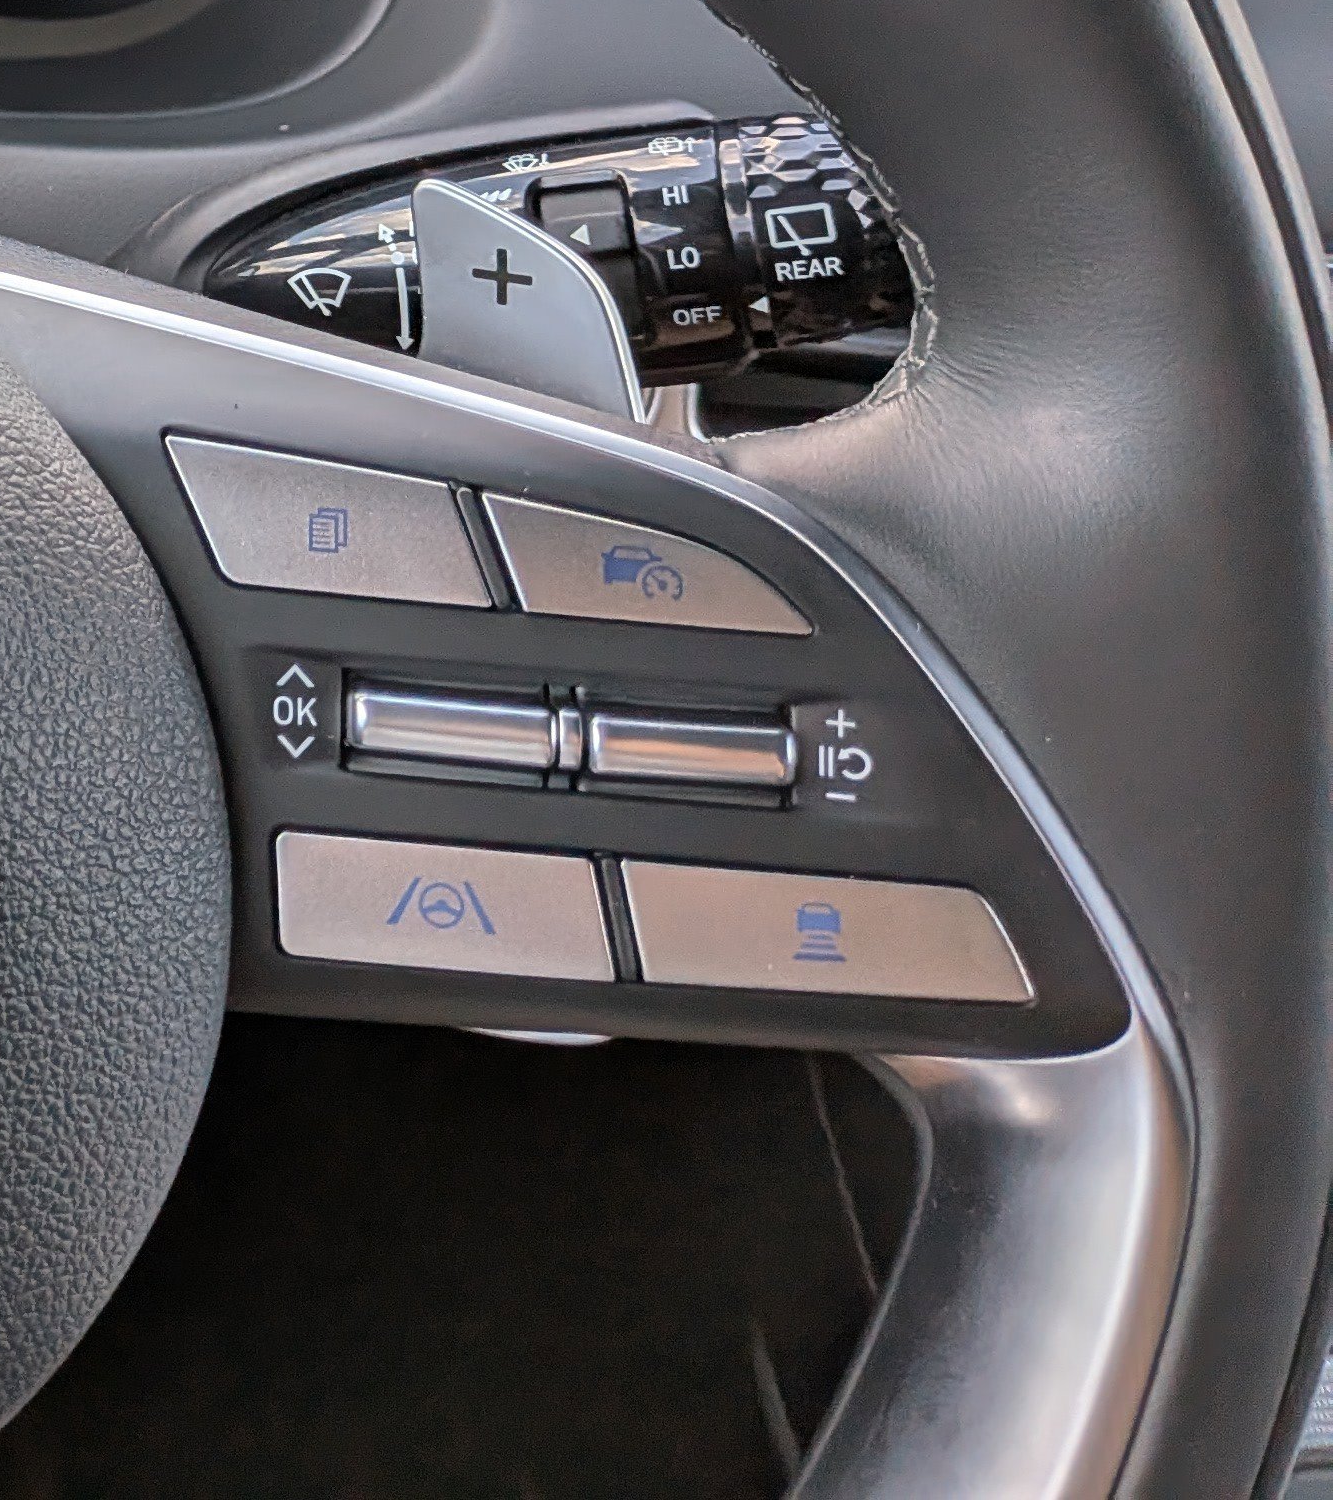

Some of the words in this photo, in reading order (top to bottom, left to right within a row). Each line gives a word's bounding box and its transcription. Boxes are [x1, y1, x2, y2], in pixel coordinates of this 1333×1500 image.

[662, 184, 690, 206] HI
[666, 246, 701, 270] LO
[774, 257, 845, 282] REAR
[672, 306, 722, 326] OFF
[273, 696, 318, 727] OK
